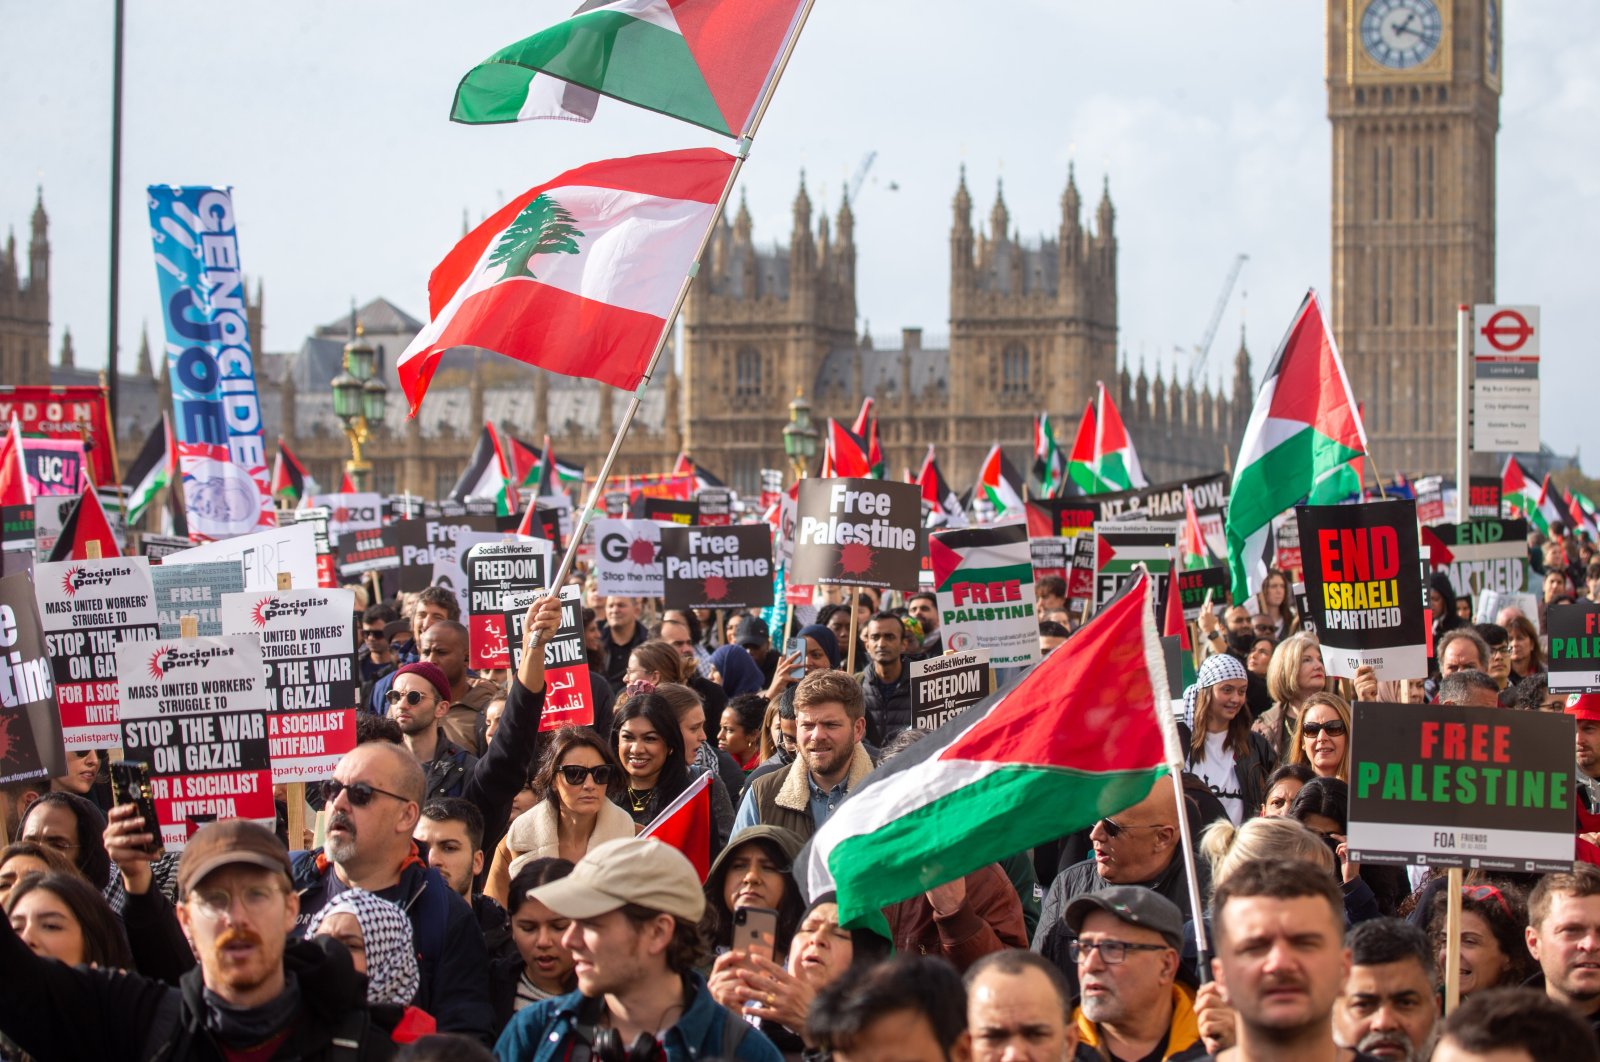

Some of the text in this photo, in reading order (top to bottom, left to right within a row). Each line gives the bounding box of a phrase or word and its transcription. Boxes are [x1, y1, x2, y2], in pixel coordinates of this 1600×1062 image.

[198, 192, 267, 473] GENOCIDE
[169, 288, 229, 444] JOE
[38, 456, 75, 485] UCU
[829, 484, 891, 516] Free
[1061, 509, 1094, 527] STOP
[356, 529, 382, 540] STOP
[688, 532, 739, 554] Free
[799, 516, 916, 551] Palestine
[1456, 522, 1504, 545] END
[346, 546, 396, 563] GENOCIDE
[356, 538, 384, 552] GAZA
[1318, 525, 1400, 582] END
[77, 568, 131, 580] Socialist
[474, 559, 537, 580] FREEDOM
[602, 571, 625, 583] Stop
[627, 571, 643, 581] the
[666, 554, 768, 579] Palestine
[74, 577, 112, 590] Party
[170, 586, 211, 602] FREE
[500, 580, 511, 590] for
[952, 580, 1022, 607] FREE
[1322, 579, 1399, 610] ISRAELI
[45, 601, 71, 614] MASS
[74, 598, 103, 612] UNITED
[105, 595, 148, 611] WORKERS'
[265, 607, 307, 620] Party
[269, 598, 328, 610] Socialist
[943, 603, 1034, 625] PALESTINE
[72, 611, 127, 627] STRUGGLE TO
[1325, 607, 1401, 630] APARTHEID
[45, 632, 85, 658] STOP
[263, 625, 345, 643] UNITED WORKERS'
[166, 645, 234, 660] Socialist
[261, 642, 320, 658] STRUGGLE TO
[513, 638, 583, 670] PSTINE
[70, 657, 91, 680] ON
[162, 658, 210, 672] Party
[278, 661, 309, 686] THE
[313, 657, 351, 684] WAR
[59, 685, 82, 704] FOR
[86, 684, 94, 702] A
[128, 677, 255, 700] MASS UNITED WORKERS'
[283, 684, 330, 710] GAZA!
[920, 670, 980, 704] FREEDOM
[158, 696, 227, 713] STRUGGLE TO
[944, 698, 956, 709] for
[125, 713, 264, 748] STOP THE WAR
[269, 712, 344, 735] A SOCIALIST
[269, 735, 325, 756] INTIFADA
[1420, 721, 1511, 763] FREE
[153, 742, 241, 773] ON GAZA!
[173, 779, 183, 798] A
[186, 773, 258, 798] SOCIALIST
[1357, 762, 1568, 810] PALESTINE
[171, 798, 236, 821] INTIFADA
[1433, 831, 1455, 848] FOA
[1461, 834, 1487, 843] FRIENDS
